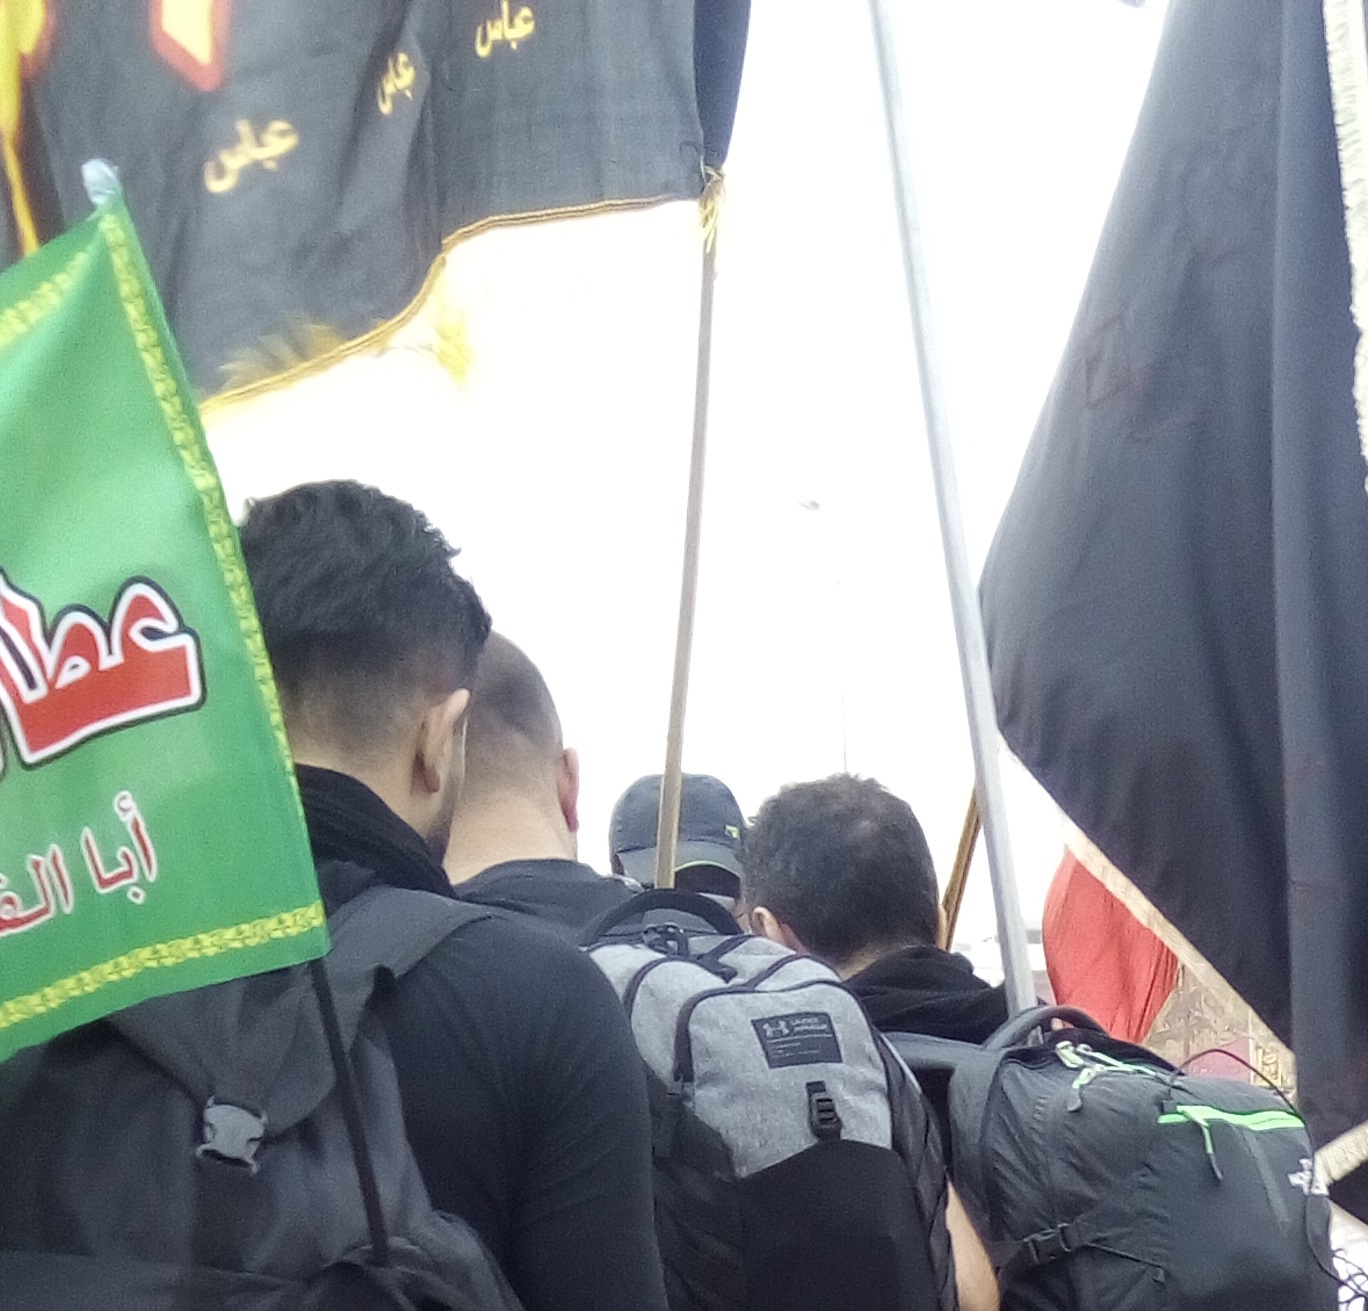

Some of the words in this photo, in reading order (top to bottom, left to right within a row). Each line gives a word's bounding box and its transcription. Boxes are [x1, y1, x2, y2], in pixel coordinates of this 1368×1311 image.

[475, 0, 536, 59] عباس
[203, 118, 299, 193] عباس
[80, 790, 158, 905] أبا
